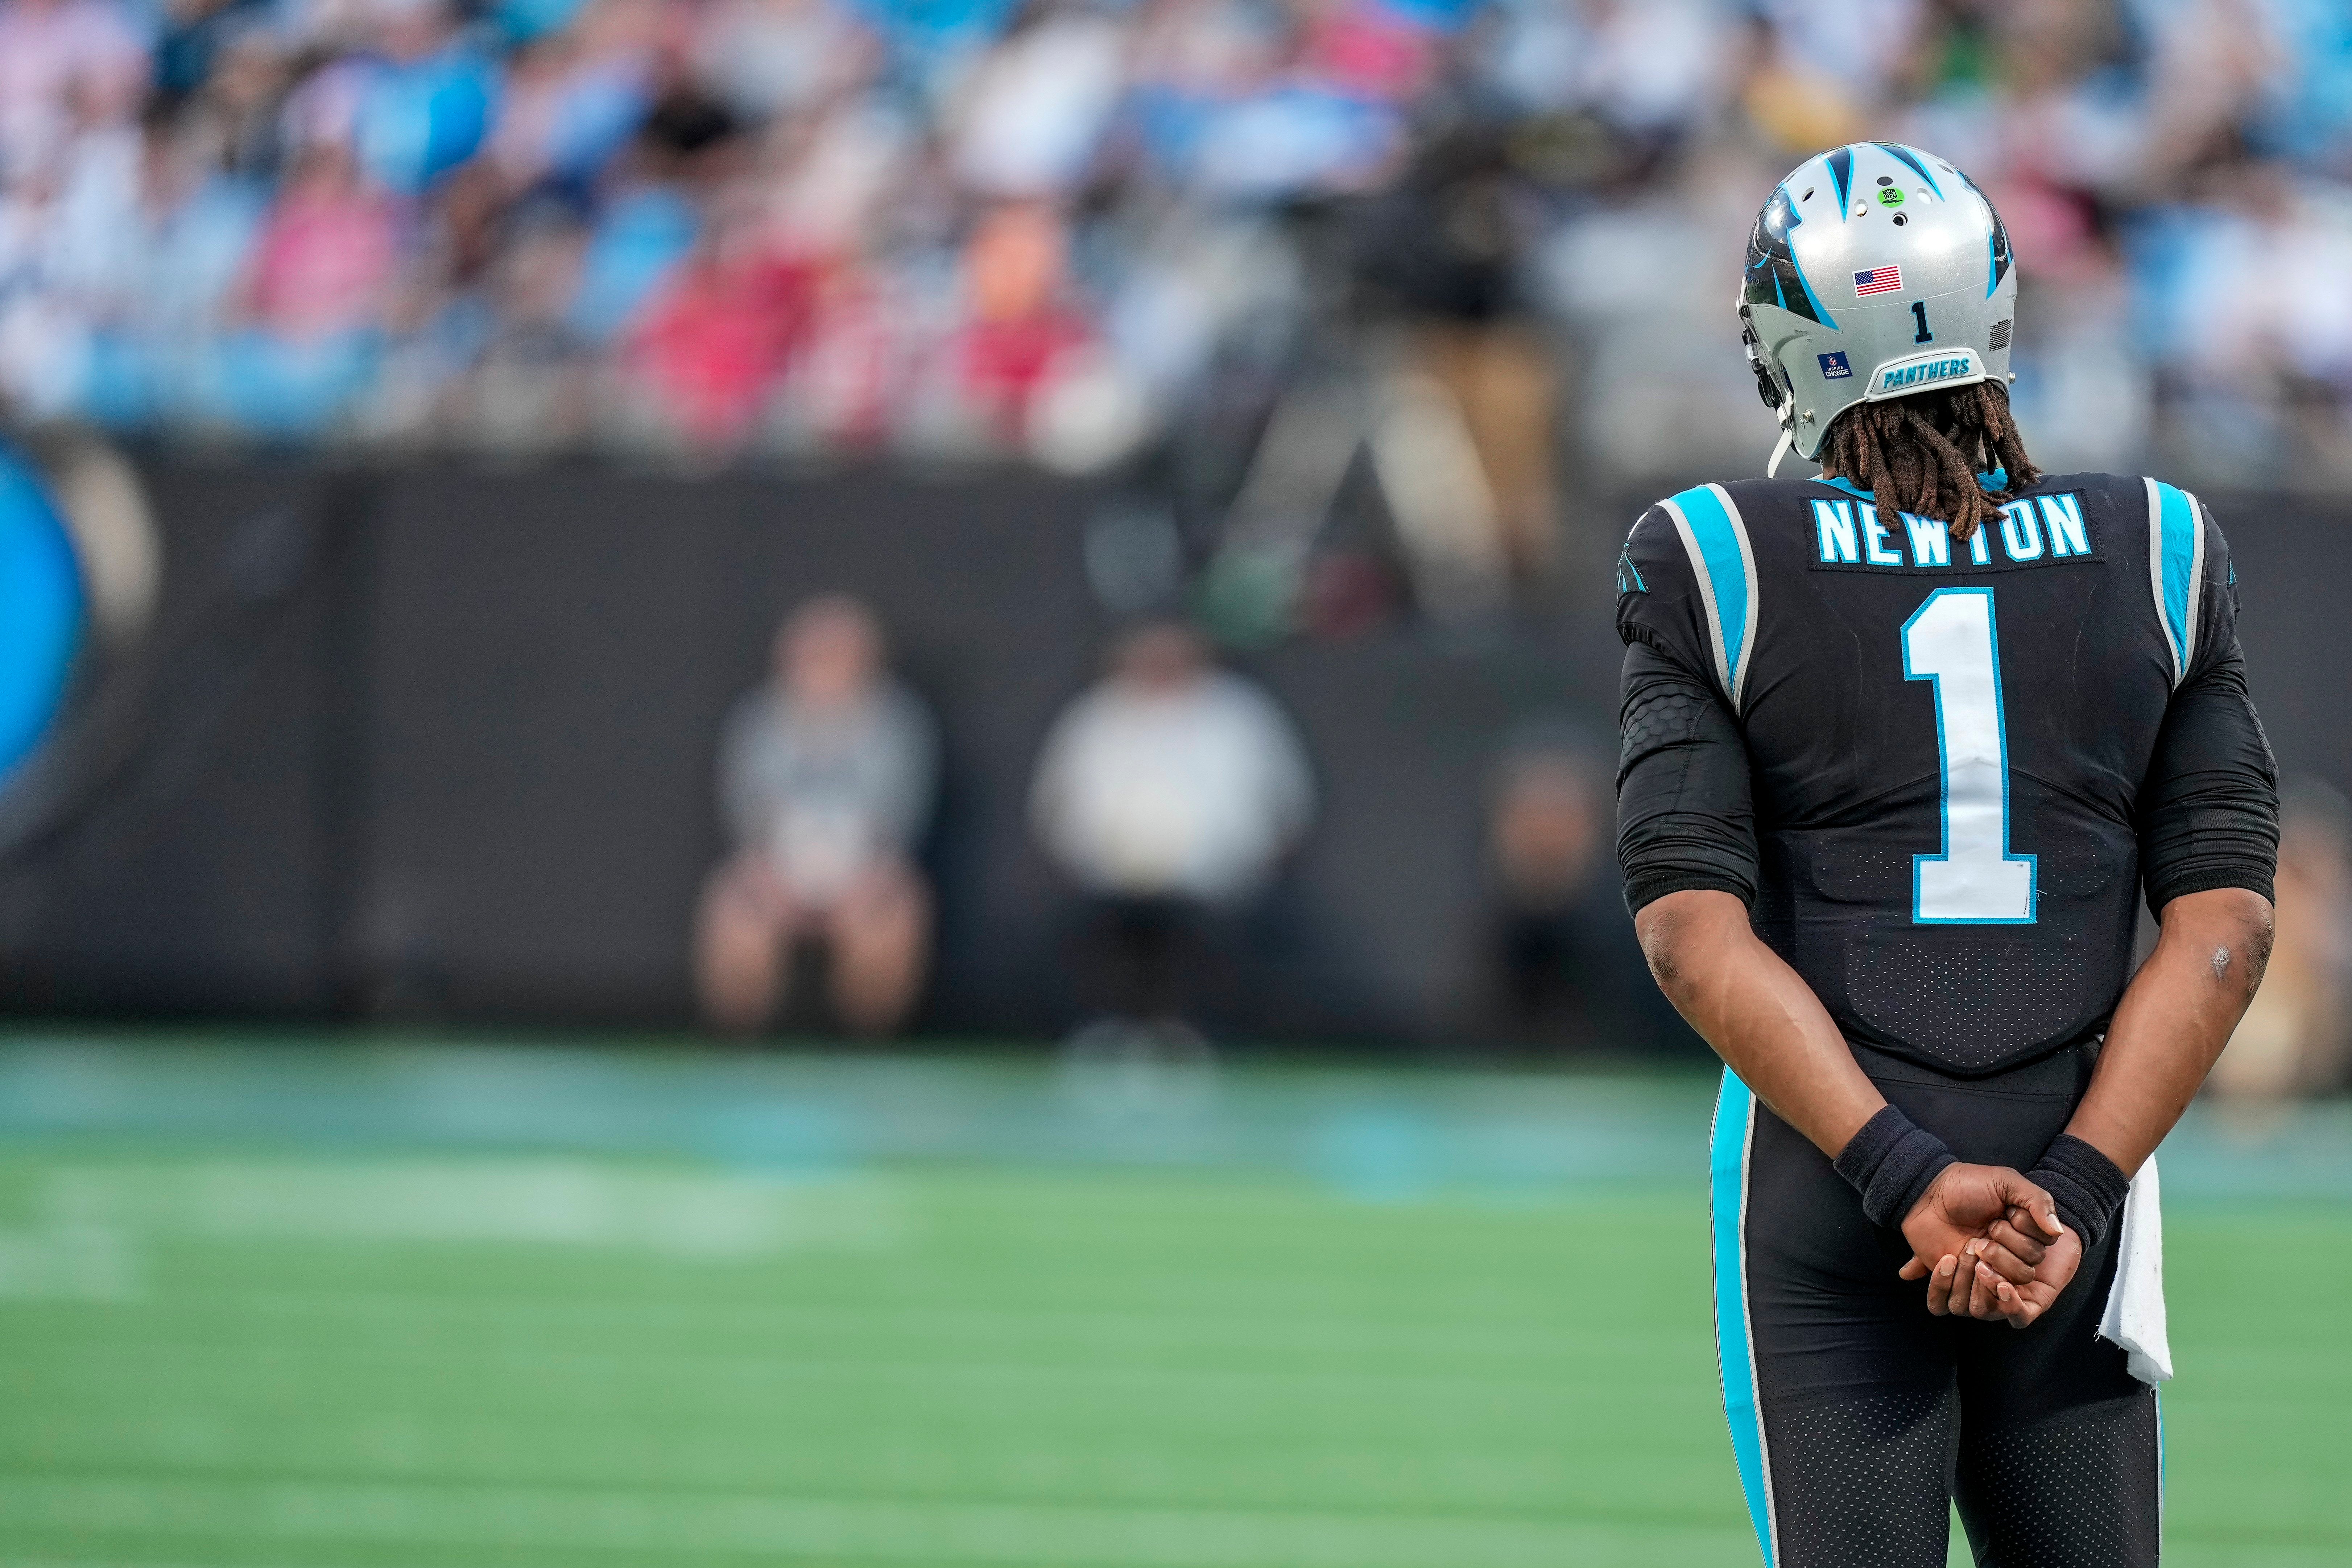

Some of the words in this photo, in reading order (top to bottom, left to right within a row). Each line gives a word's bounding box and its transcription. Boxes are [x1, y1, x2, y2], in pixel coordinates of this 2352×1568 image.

[1911, 300, 1934, 344] 1
[1883, 357, 1970, 388] PANTHERS
[1901, 587, 2037, 924] 1
